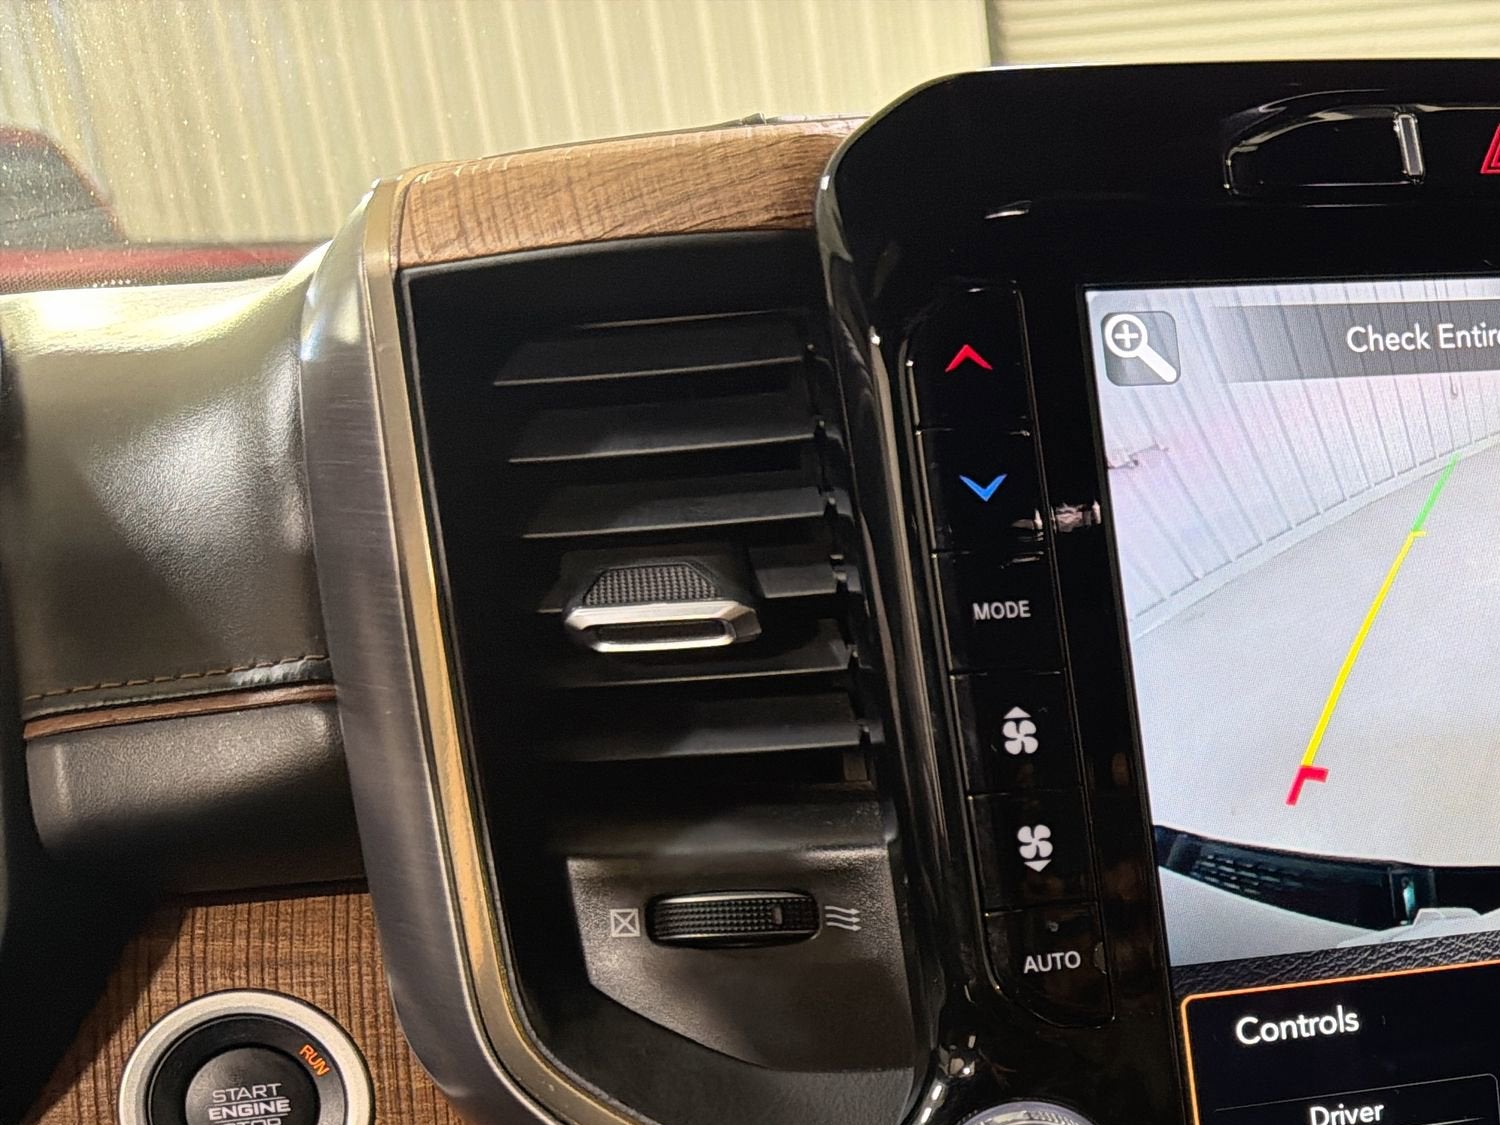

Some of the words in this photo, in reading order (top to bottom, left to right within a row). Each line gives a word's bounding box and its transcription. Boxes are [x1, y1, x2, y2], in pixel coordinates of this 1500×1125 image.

[1346, 323, 1431, 353] Check
[973, 600, 1031, 620] MODE
[1023, 951, 1081, 973] AUTO
[1236, 1006, 1359, 1046] Controls
[300, 1044, 330, 1076] RUN
[212, 1083, 282, 1103] START
[209, 1099, 291, 1121] ENGINE
